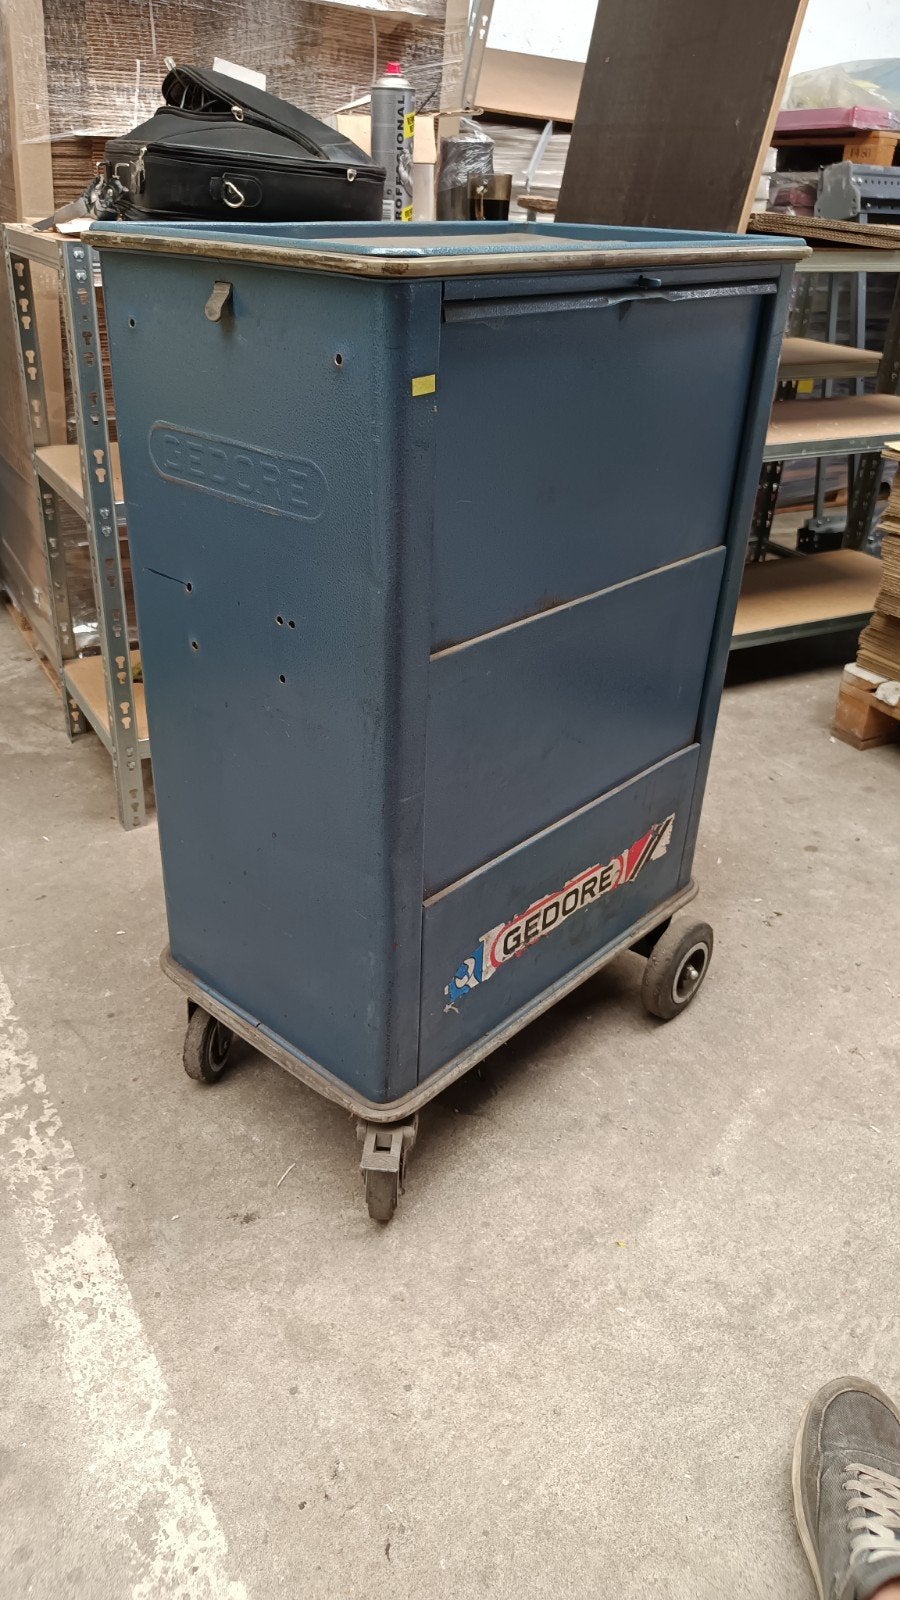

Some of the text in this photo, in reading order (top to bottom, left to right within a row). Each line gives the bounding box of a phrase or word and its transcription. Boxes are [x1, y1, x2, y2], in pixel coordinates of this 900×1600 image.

[395, 95, 405, 220] ROFEIONAL
[162, 433, 309, 506] GEDORE
[503, 864, 614, 956] GEDORE
